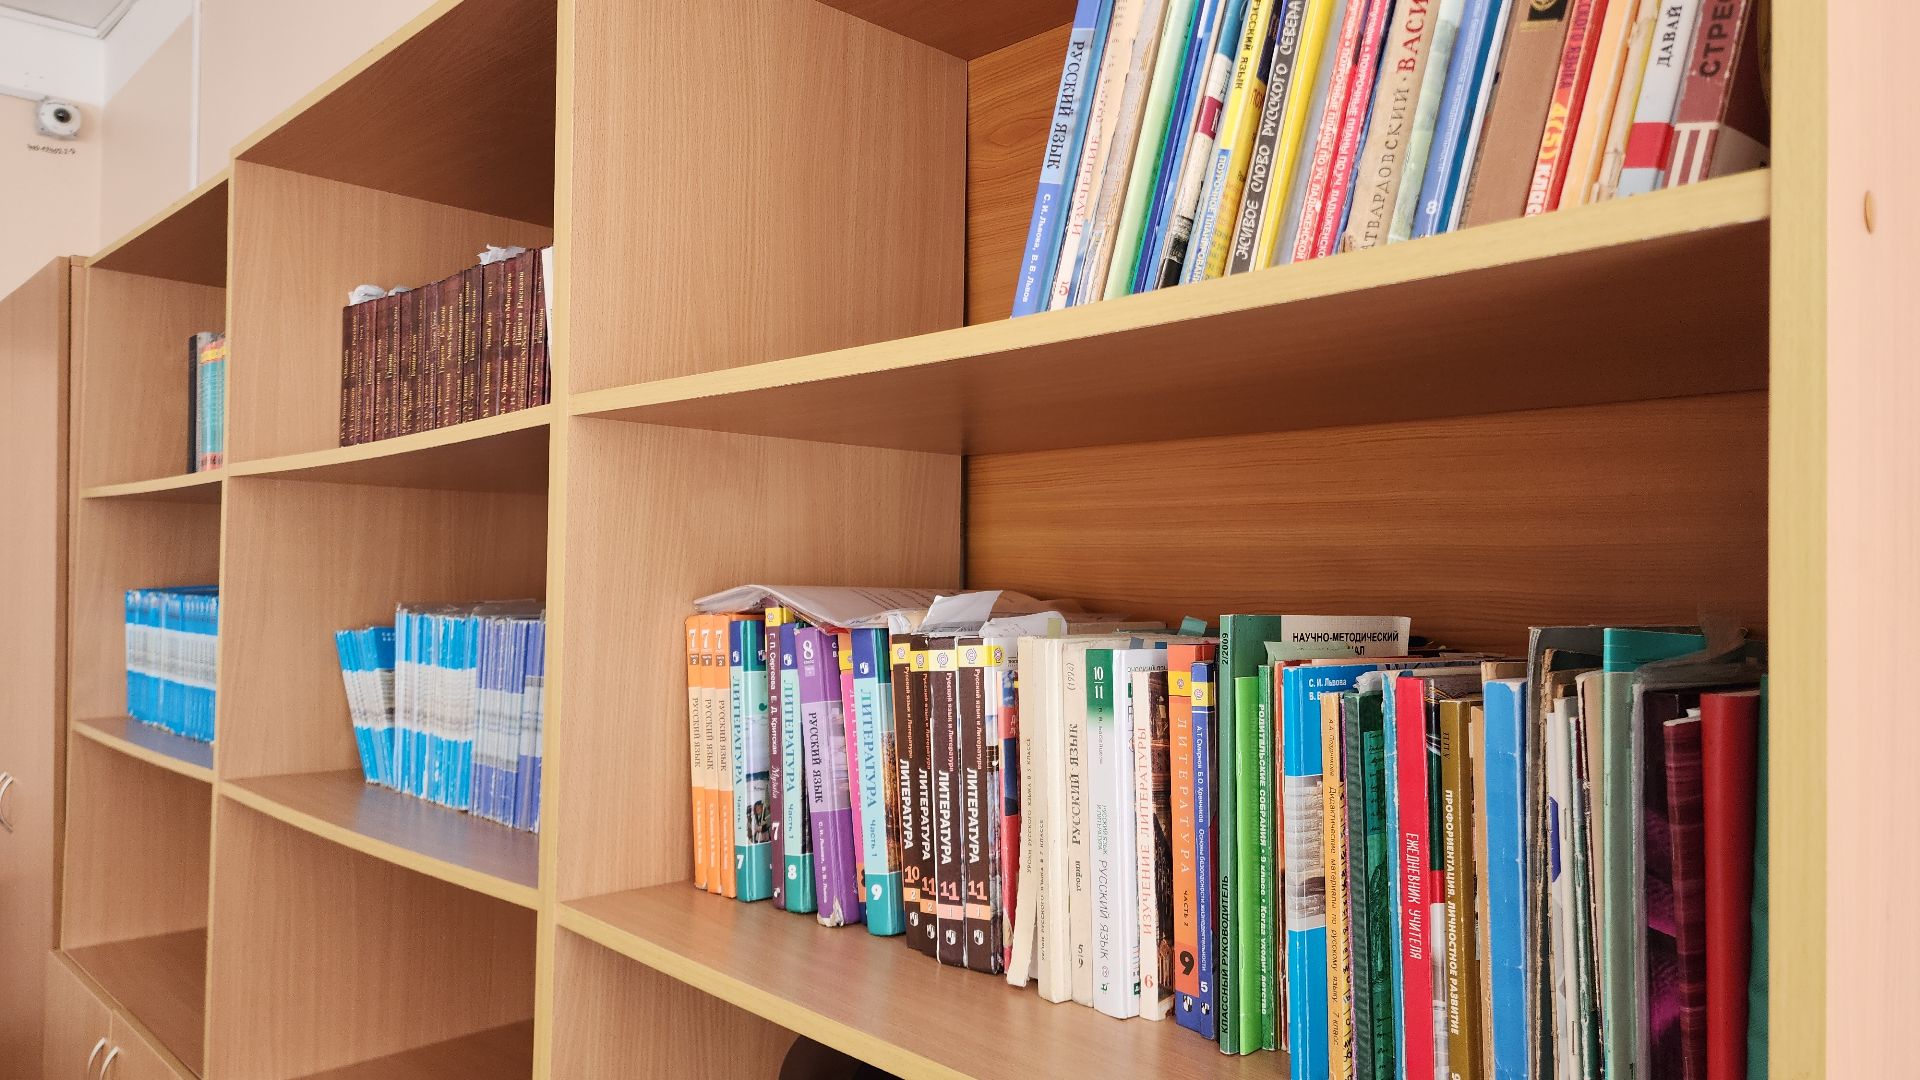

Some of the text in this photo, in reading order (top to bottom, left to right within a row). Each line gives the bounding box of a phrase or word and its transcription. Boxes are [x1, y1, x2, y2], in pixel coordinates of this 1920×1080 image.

[1656, 3, 1683, 68] ДАВАЙ
[1700, 0, 1738, 78] СТРЕ
[1234, 55, 1248, 90] ЯЗЫК
[1353, 53, 1371, 116] ПОУРОЧНЫЕ
[1046, 41, 1085, 170] РУССКИЙ ЯЗЫК
[1235, 200, 1260, 260] ЖИВОЕ
[1250, 144, 1272, 193] СЛОВО
[1262, 62, 1288, 137] РУССКОГО
[1279, 0, 1303, 55] СЕВЕРА
[1320, 111, 1335, 148] ПЛАНЫ
[1341, 116, 1356, 152] ПЛАНЫ
[1311, 165, 1324, 182] УЧ.
[1315, 149, 1327, 166] ПО
[1337, 155, 1348, 171] ПО
[1208, 154, 1228, 212] ПОУРОЧНОЕ
[1332, 171, 1344, 188] УЧ.
[1426, 201, 1439, 215] 8
[1021, 275, 1033, 302] Львов
[689, 628, 697, 649] 7
[701, 629, 710, 649] 7
[769, 641, 775, 650] П.
[803, 640, 814, 660] 8
[1220, 632, 1229, 666] 2/2009
[1292, 630, 1399, 643] НАУЧНО-МЕТОДИЧЕСКИЙ
[768, 652, 776, 689] Сергеева
[1093, 666, 1104, 680] 10
[1308, 677, 1347, 688] С. И. Львова
[770, 695, 776, 703] Е.
[1095, 685, 1104, 699] 11
[1309, 692, 1316, 701] В.
[691, 698, 699, 738] РУССКИЙ
[717, 700, 726, 742] РУССКИЙ
[770, 706, 777, 715] Д.
[704, 699, 713, 769] РУССКИЙ ЯЗЫК
[732, 676, 742, 785] ЛИТЕРАТУРА
[770, 717, 778, 754] Критская
[783, 680, 796, 793] ЛИТЕРАТУРА
[1257, 703, 1266, 787] РОДИТЕЛЬСКИЕ
[808, 712, 823, 803] РУССКИЙ ЯЗЫК
[860, 688, 877, 808] ЛИТЕРАТУРА
[1069, 723, 1082, 846] РУССКИЙ ЯЗЫК
[1178, 717, 1192, 875] ЛИТЕРАТУРА
[899, 758, 913, 850] ЛИТЕРАТУРА
[918, 767, 931, 861] ЛИТЕРАТУРА
[938, 770, 952, 865] ЛИТЕРАТУРА
[966, 767, 981, 864] ЛИТЕРАТУРА
[1258, 789, 1266, 846] СОБРАНИЯ
[771, 823, 780, 841] 7
[868, 819, 877, 849] Часть
[1138, 727, 1151, 934] ИЗУЧЕНИЕ ЛИТЕРАТУРЫ
[737, 855, 744, 870] 7
[787, 864, 797, 880] 8
[904, 865, 920, 884] 10
[870, 884, 883, 900] 9
[911, 892, 916, 900] 2
[921, 876, 937, 896] 11
[940, 881, 960, 901] 11
[968, 880, 988, 901] 11
[1328, 858, 1336, 909] материалы
[1404, 832, 1423, 959] ЕЖЕДНЕВНИК УЧИТЕЛЯ
[928, 902, 933, 912] 2
[1099, 860, 1110, 961] РУССКИЙ ЯЗЫК
[1180, 890, 1190, 918] ЧАСТЬ
[1258, 905, 1267, 935] Когда
[1330, 913, 1335, 924] по
[1445, 789, 1459, 1035] ПРОФОРИЕНТАЦИЯ. ЛИЧНОСТНОЕ РАЗВИТИЕ
[1179, 950, 1195, 976] 9
[1219, 875, 1230, 1034] КЛАССНЫЙ РУКОВОДИТЕЛЬ
[1258, 938, 1266, 972] уходит
[1328, 929, 1337, 971] русскому
[1144, 974, 1154, 989] 6
[1200, 981, 1209, 993] 5
[1259, 974, 1267, 1014] детство
